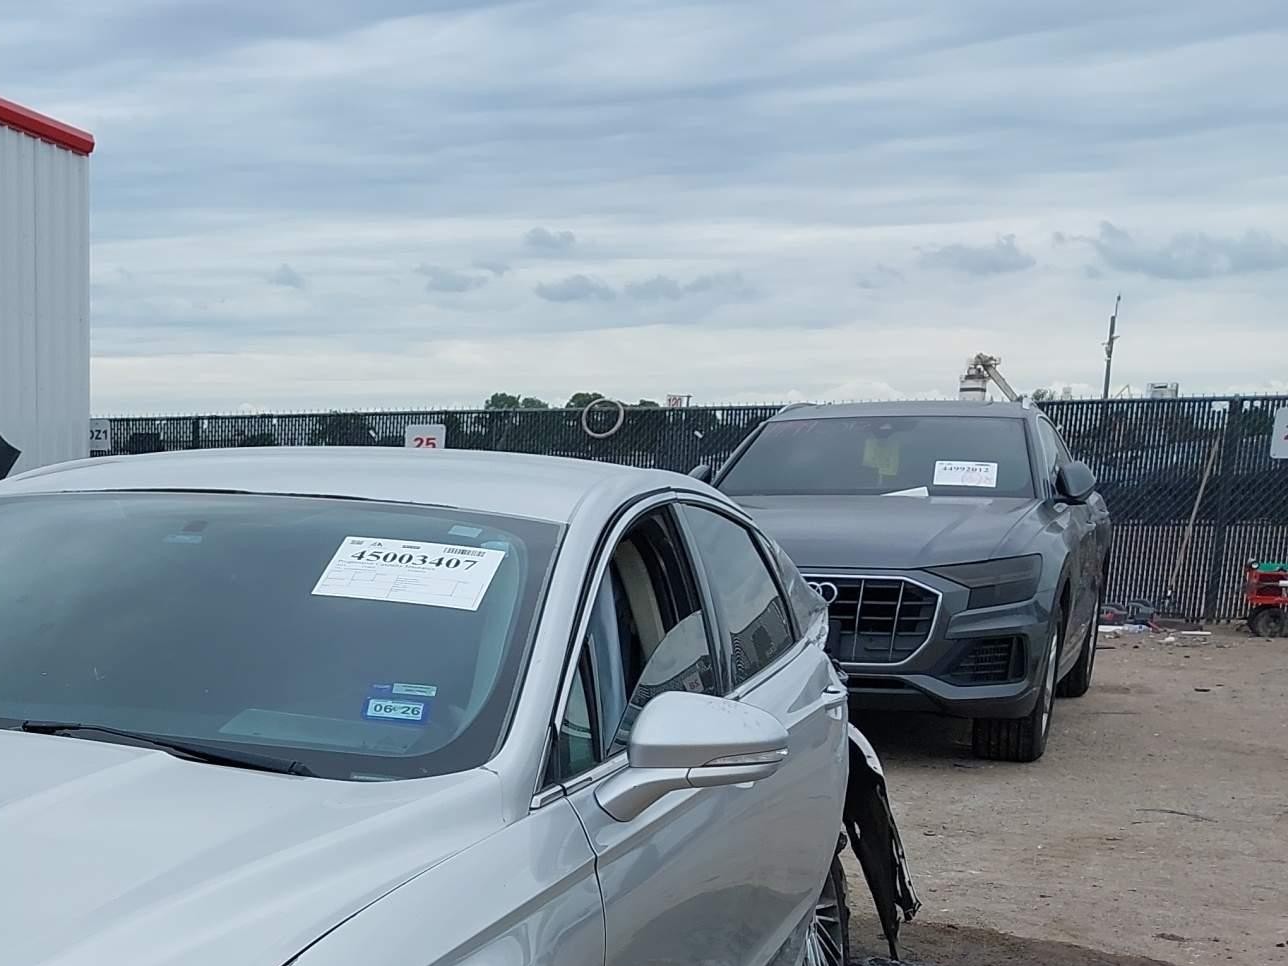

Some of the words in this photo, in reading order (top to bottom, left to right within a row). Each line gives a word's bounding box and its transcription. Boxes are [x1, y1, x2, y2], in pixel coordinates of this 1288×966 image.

[413, 436, 437, 449] 25
[350, 548, 480, 571] 45003407
[373, 703, 393, 714] 06
[400, 705, 421, 716] 26
